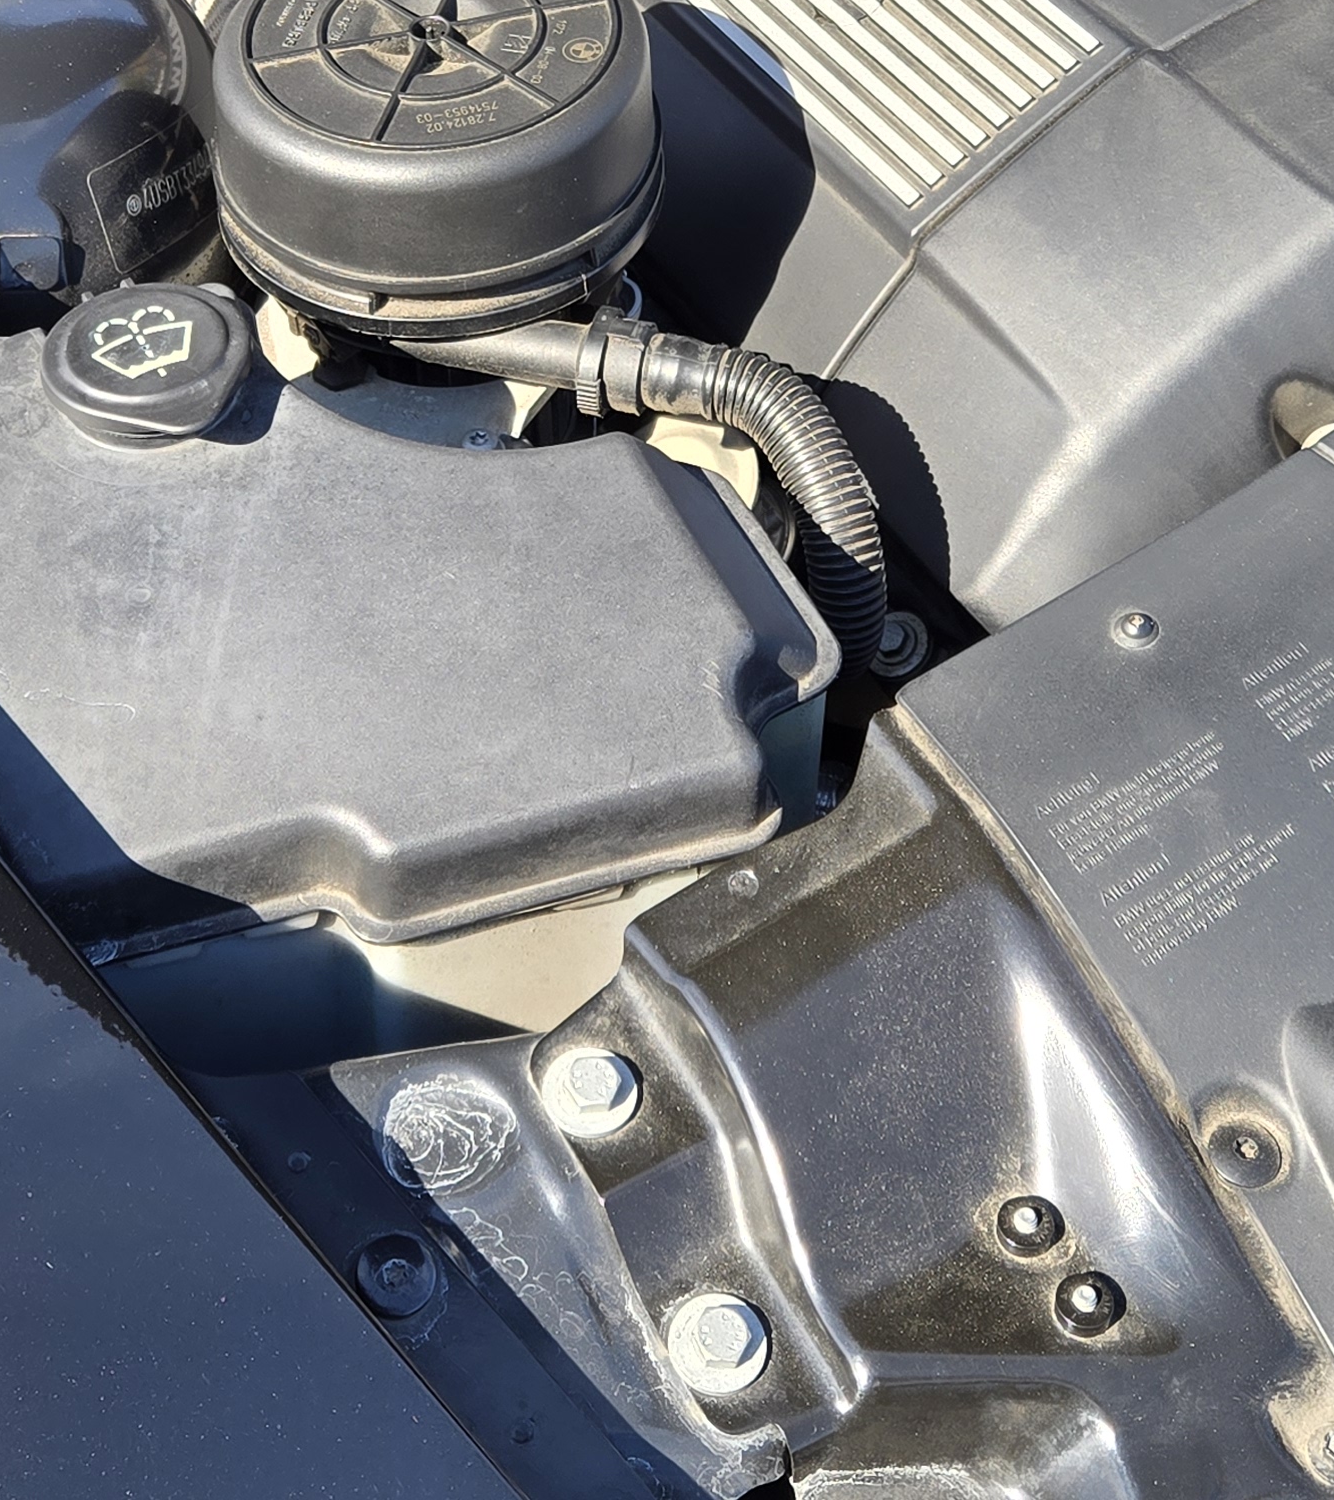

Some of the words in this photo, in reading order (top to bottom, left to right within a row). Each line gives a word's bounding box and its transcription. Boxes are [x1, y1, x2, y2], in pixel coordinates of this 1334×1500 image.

[426, 112, 496, 134] 7.28124.02
[1254, 684, 1286, 709] BMW
[1187, 759, 1218, 784] BMW
[1089, 786, 1121, 813] BMW
[1112, 901, 1145, 929] BMW
